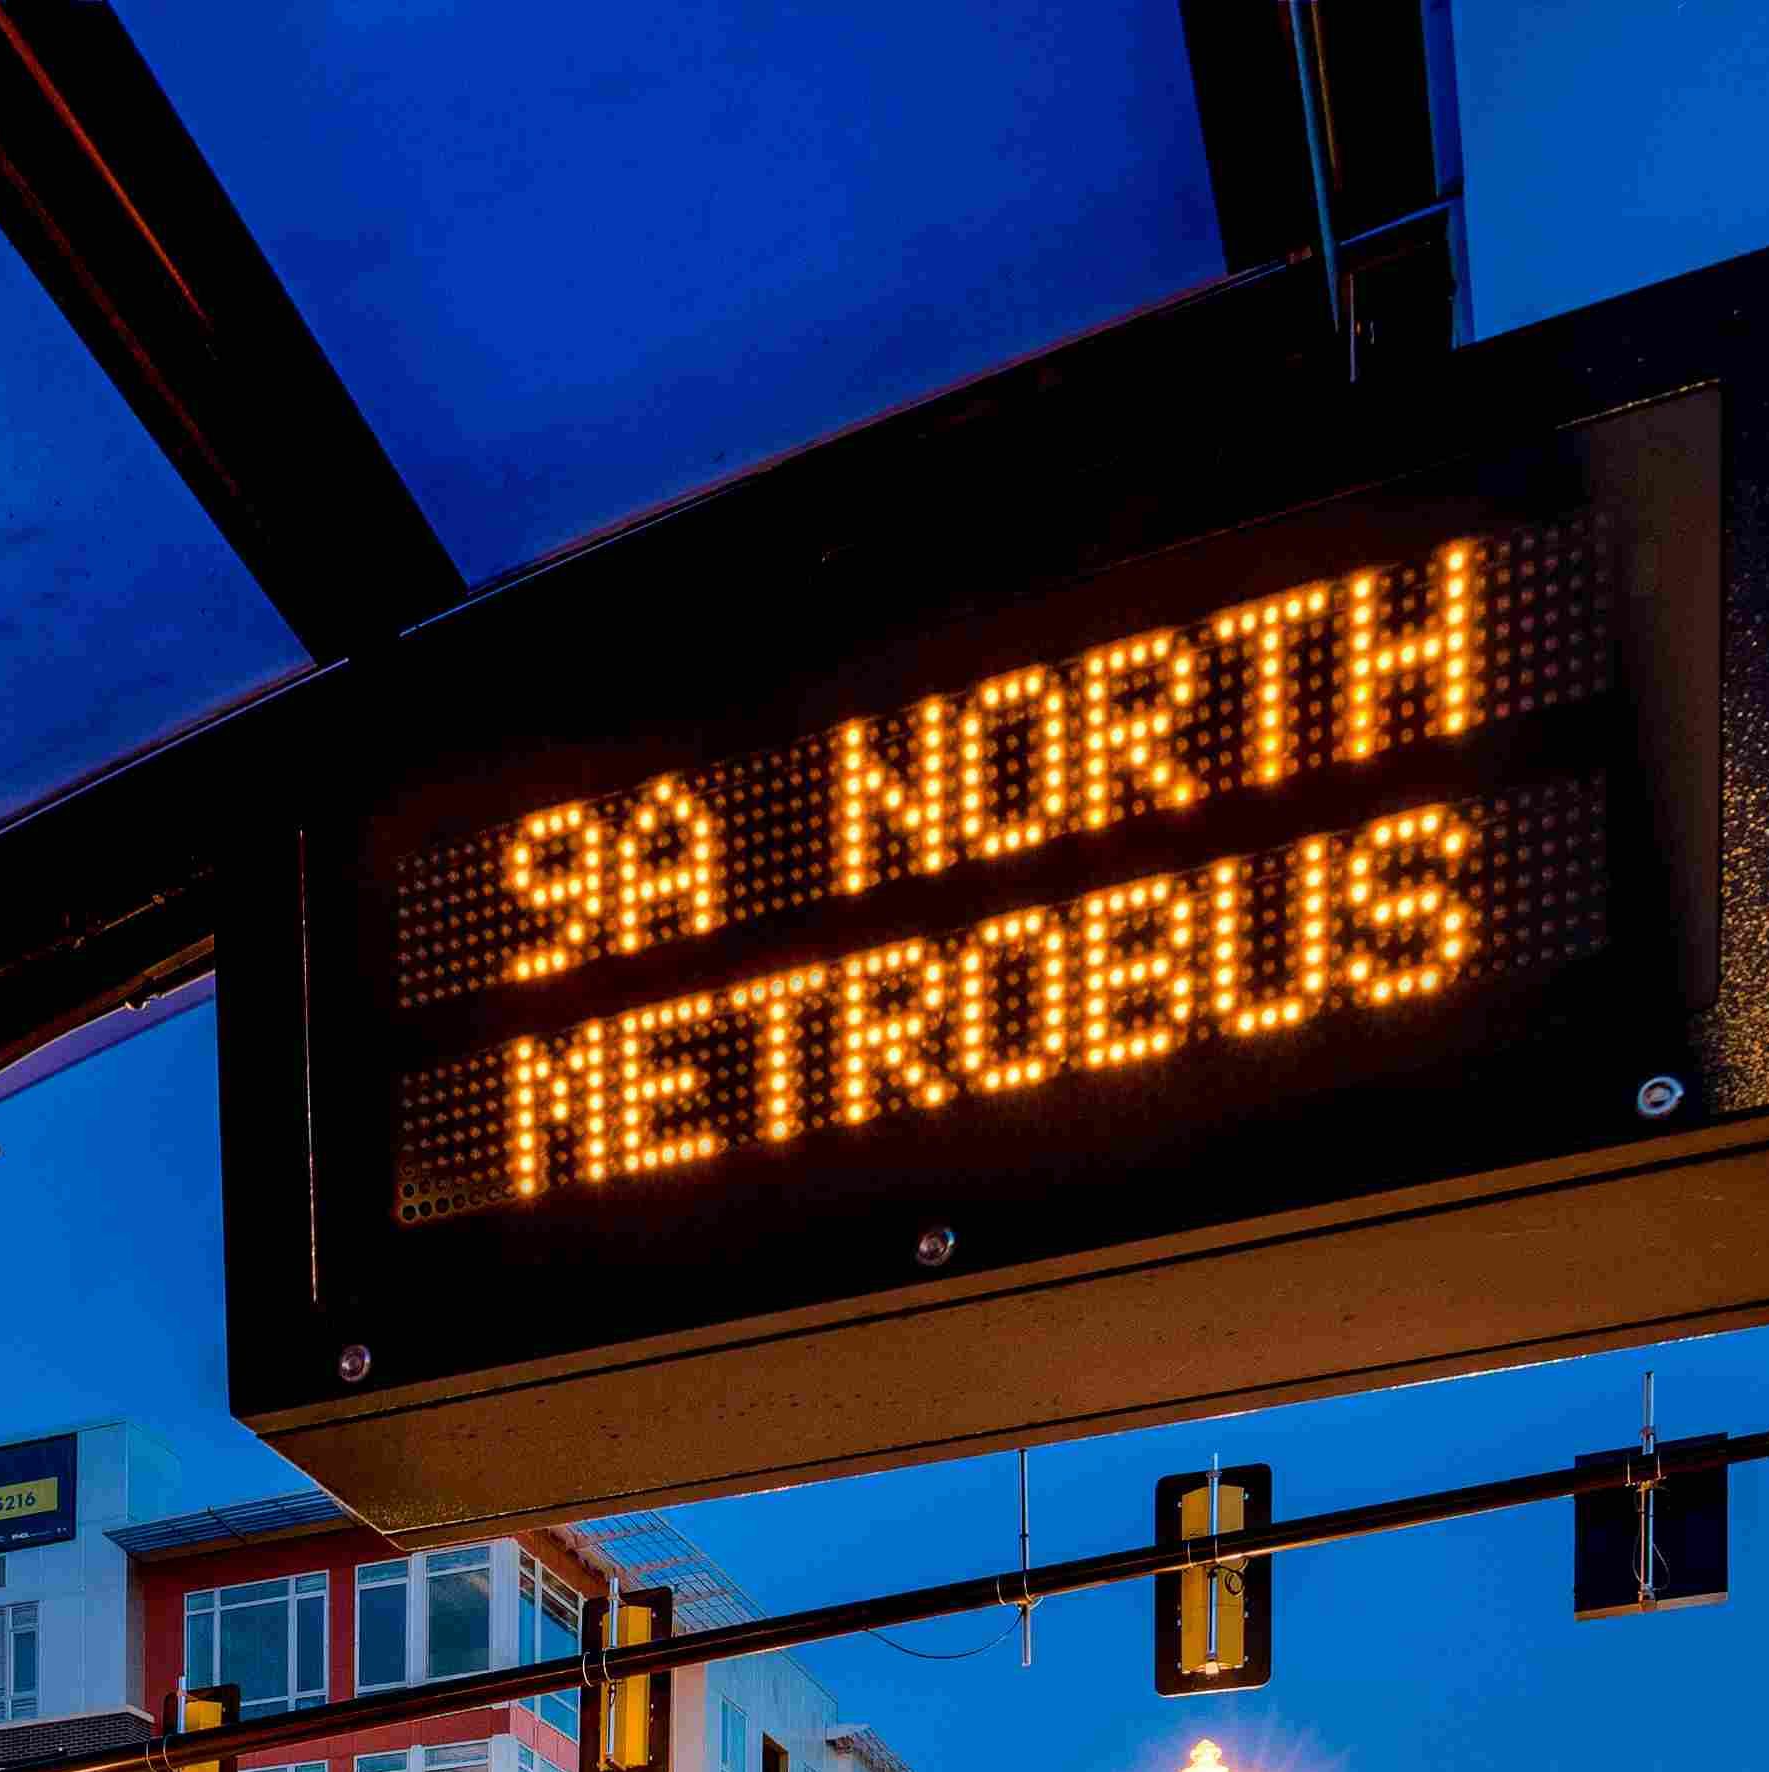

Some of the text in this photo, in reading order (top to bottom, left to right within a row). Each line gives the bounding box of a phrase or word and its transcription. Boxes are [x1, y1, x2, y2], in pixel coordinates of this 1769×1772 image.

[508, 534, 1477, 984] 9A NORTH
[508, 799, 1474, 1203] METROBUS
